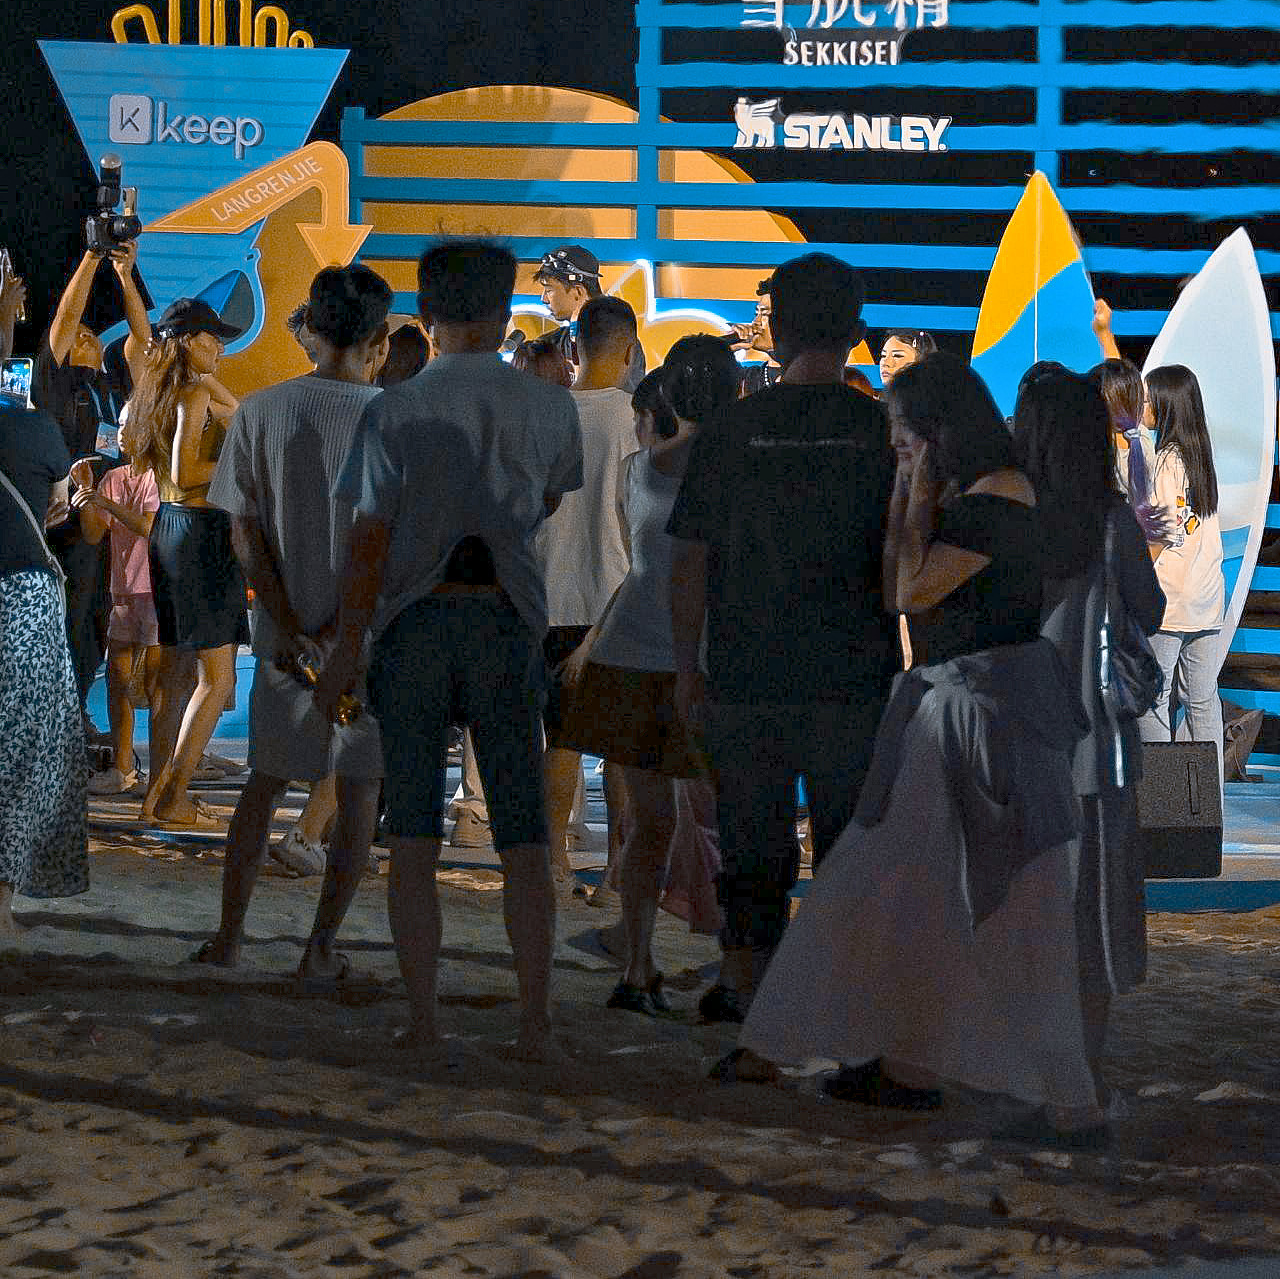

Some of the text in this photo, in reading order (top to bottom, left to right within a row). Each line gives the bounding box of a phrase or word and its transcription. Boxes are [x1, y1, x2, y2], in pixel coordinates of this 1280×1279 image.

[783, 39, 899, 67] SEKKISEI
[157, 100, 264, 160] keep
[783, 115, 953, 151] STANLEY
[211, 156, 323, 222] LANGRENJIE
